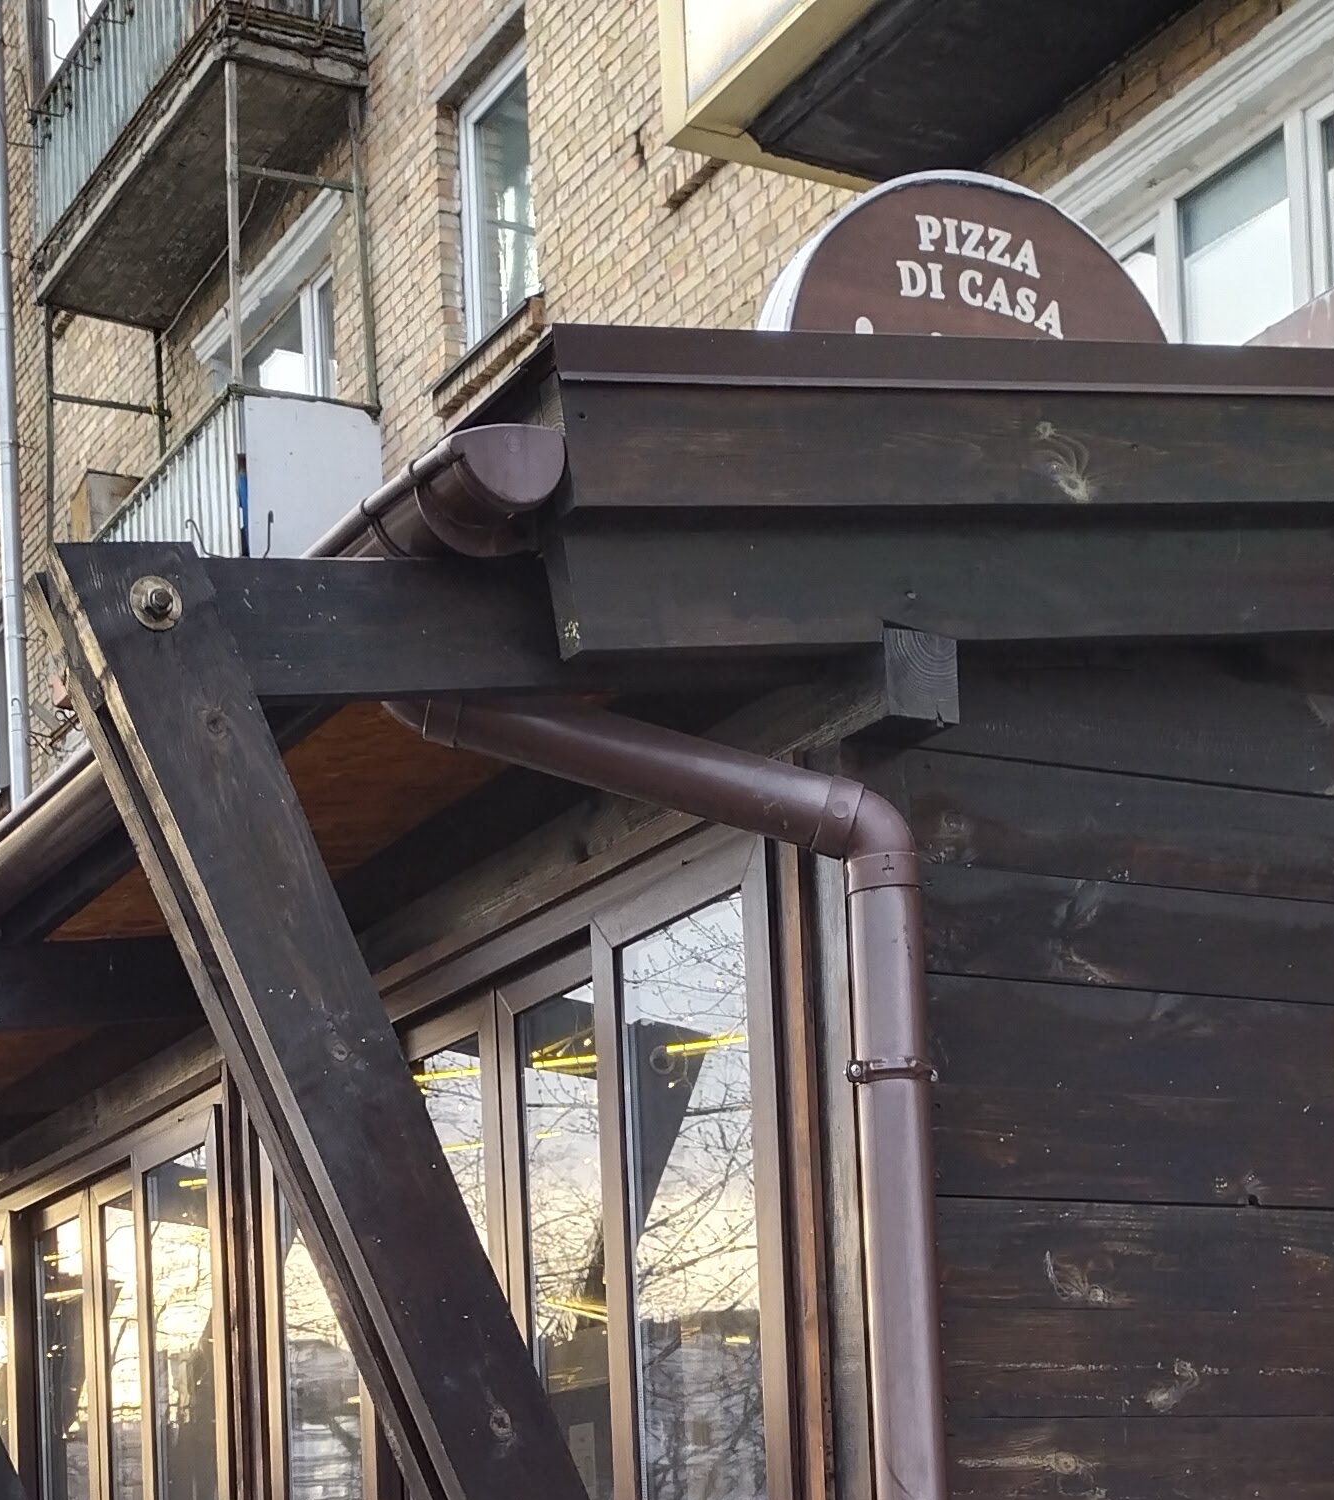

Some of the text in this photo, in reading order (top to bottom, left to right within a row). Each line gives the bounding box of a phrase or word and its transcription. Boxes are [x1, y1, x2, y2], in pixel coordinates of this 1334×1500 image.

[915, 214, 1041, 279] PIZZA
[896, 260, 1064, 340] DI CASA
